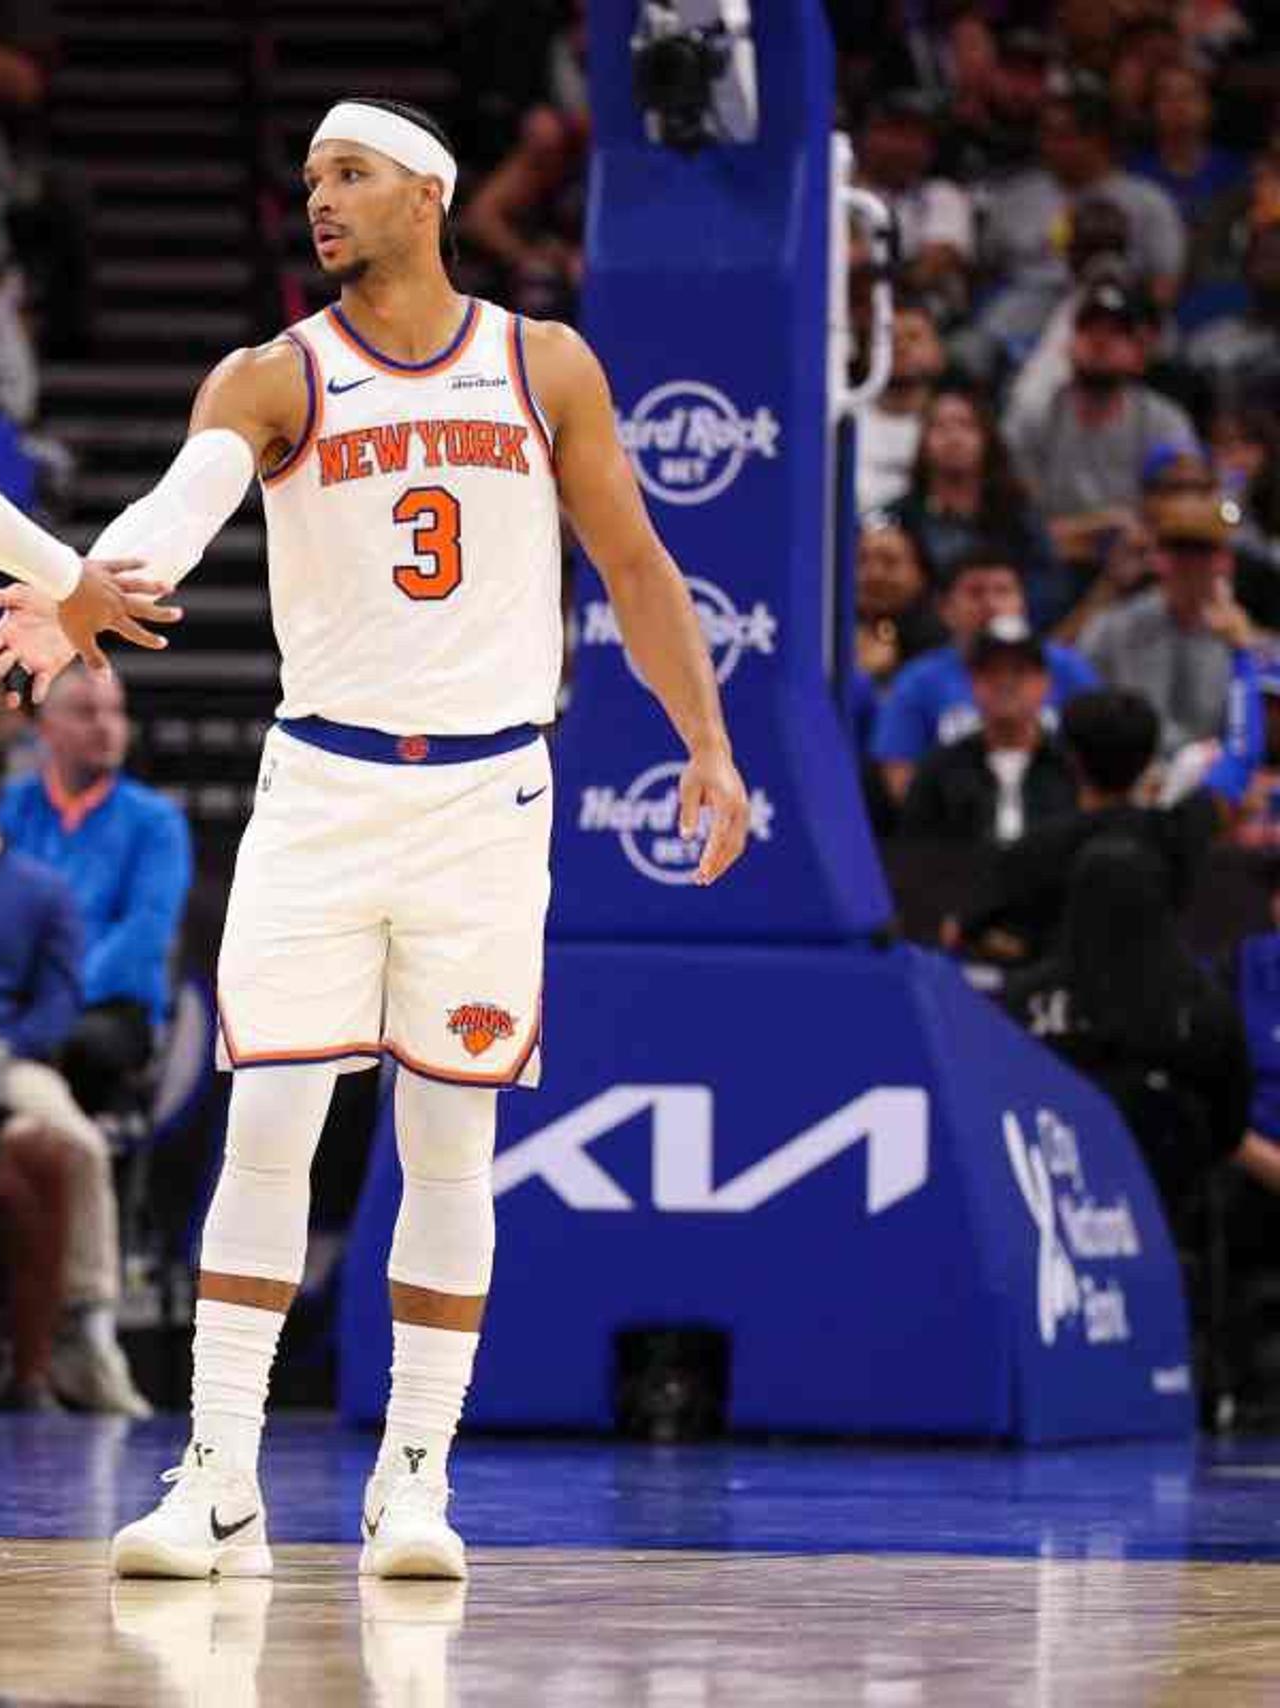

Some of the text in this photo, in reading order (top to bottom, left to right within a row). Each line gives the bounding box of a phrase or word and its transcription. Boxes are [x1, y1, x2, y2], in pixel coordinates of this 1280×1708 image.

[318, 418, 530, 487] NEW YORK
[614, 407, 780, 459] ard Rock
[392, 485, 463, 601] 3
